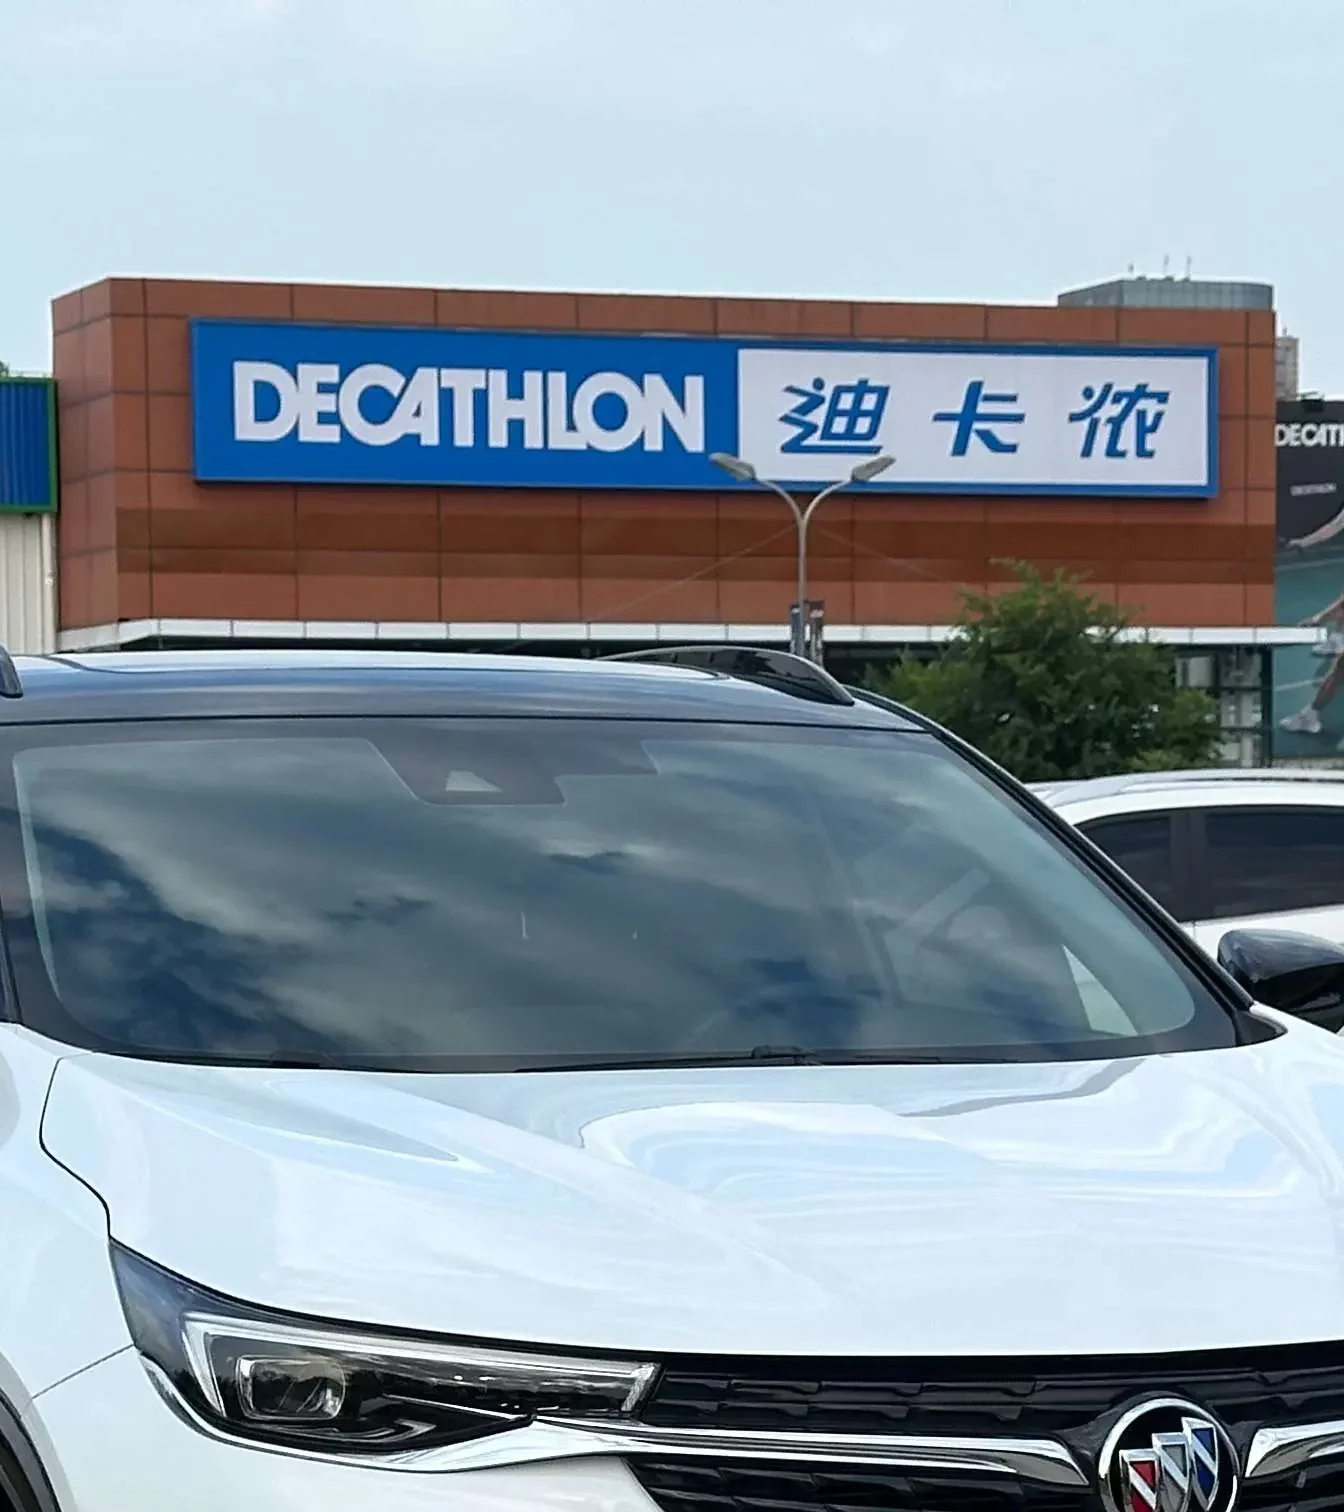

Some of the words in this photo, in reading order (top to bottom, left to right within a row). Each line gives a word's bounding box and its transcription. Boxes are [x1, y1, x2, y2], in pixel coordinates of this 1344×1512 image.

[232, 360, 705, 454] DECATHLON
[778, 376, 1172, 460] 迪卡侬
